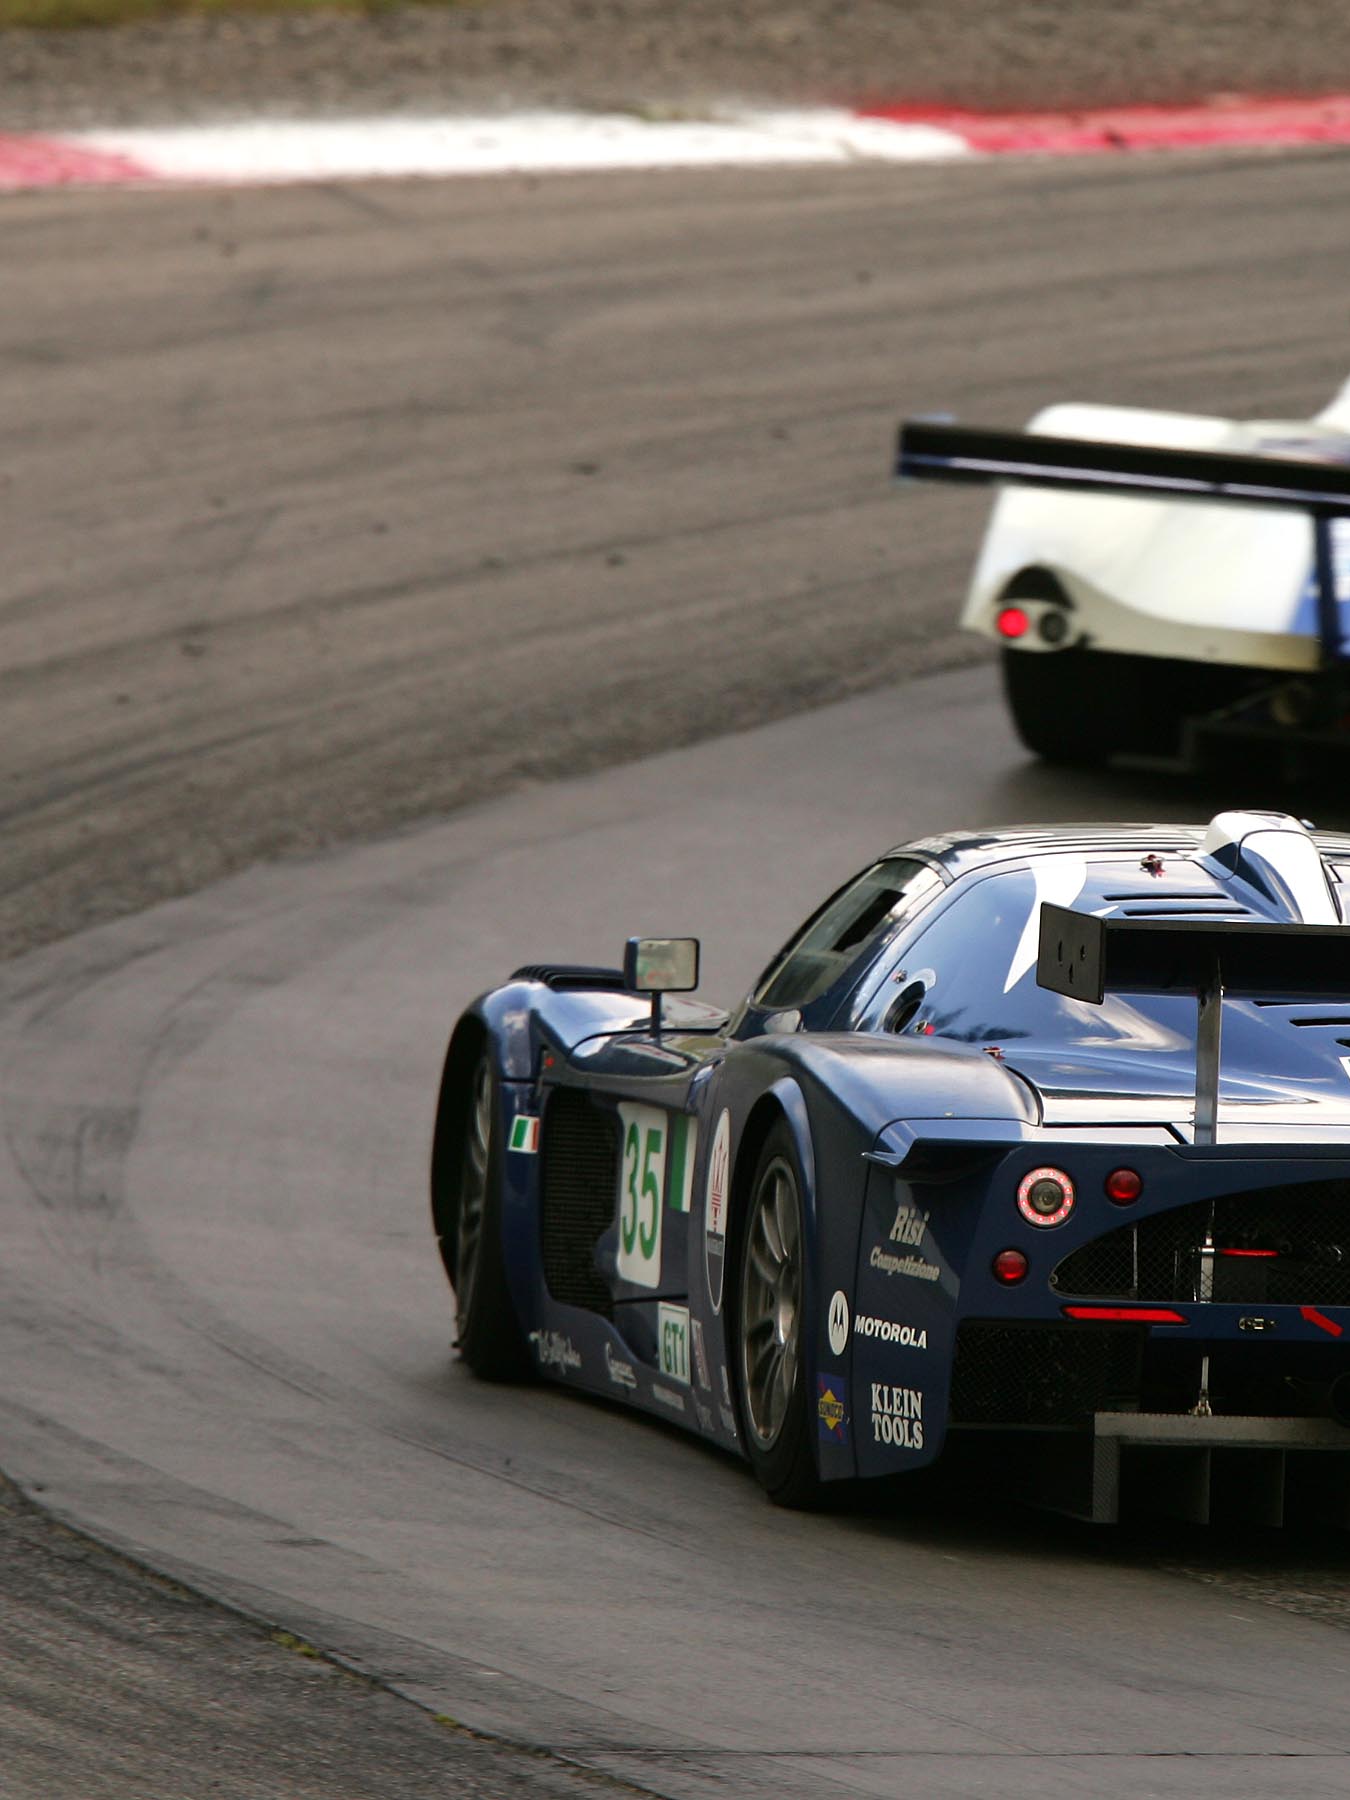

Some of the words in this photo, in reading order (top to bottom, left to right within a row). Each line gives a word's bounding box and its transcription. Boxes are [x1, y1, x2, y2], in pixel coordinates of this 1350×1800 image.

[623, 1122, 662, 1260] 35
[889, 1206, 930, 1246] Risi
[870, 1246, 941, 1281] Competizione
[664, 1321, 685, 1376] GT1
[854, 1315, 927, 1349] MOTOROLA
[871, 1383, 922, 1419] KLEIN
[872, 1413, 923, 1449] TOOLS
